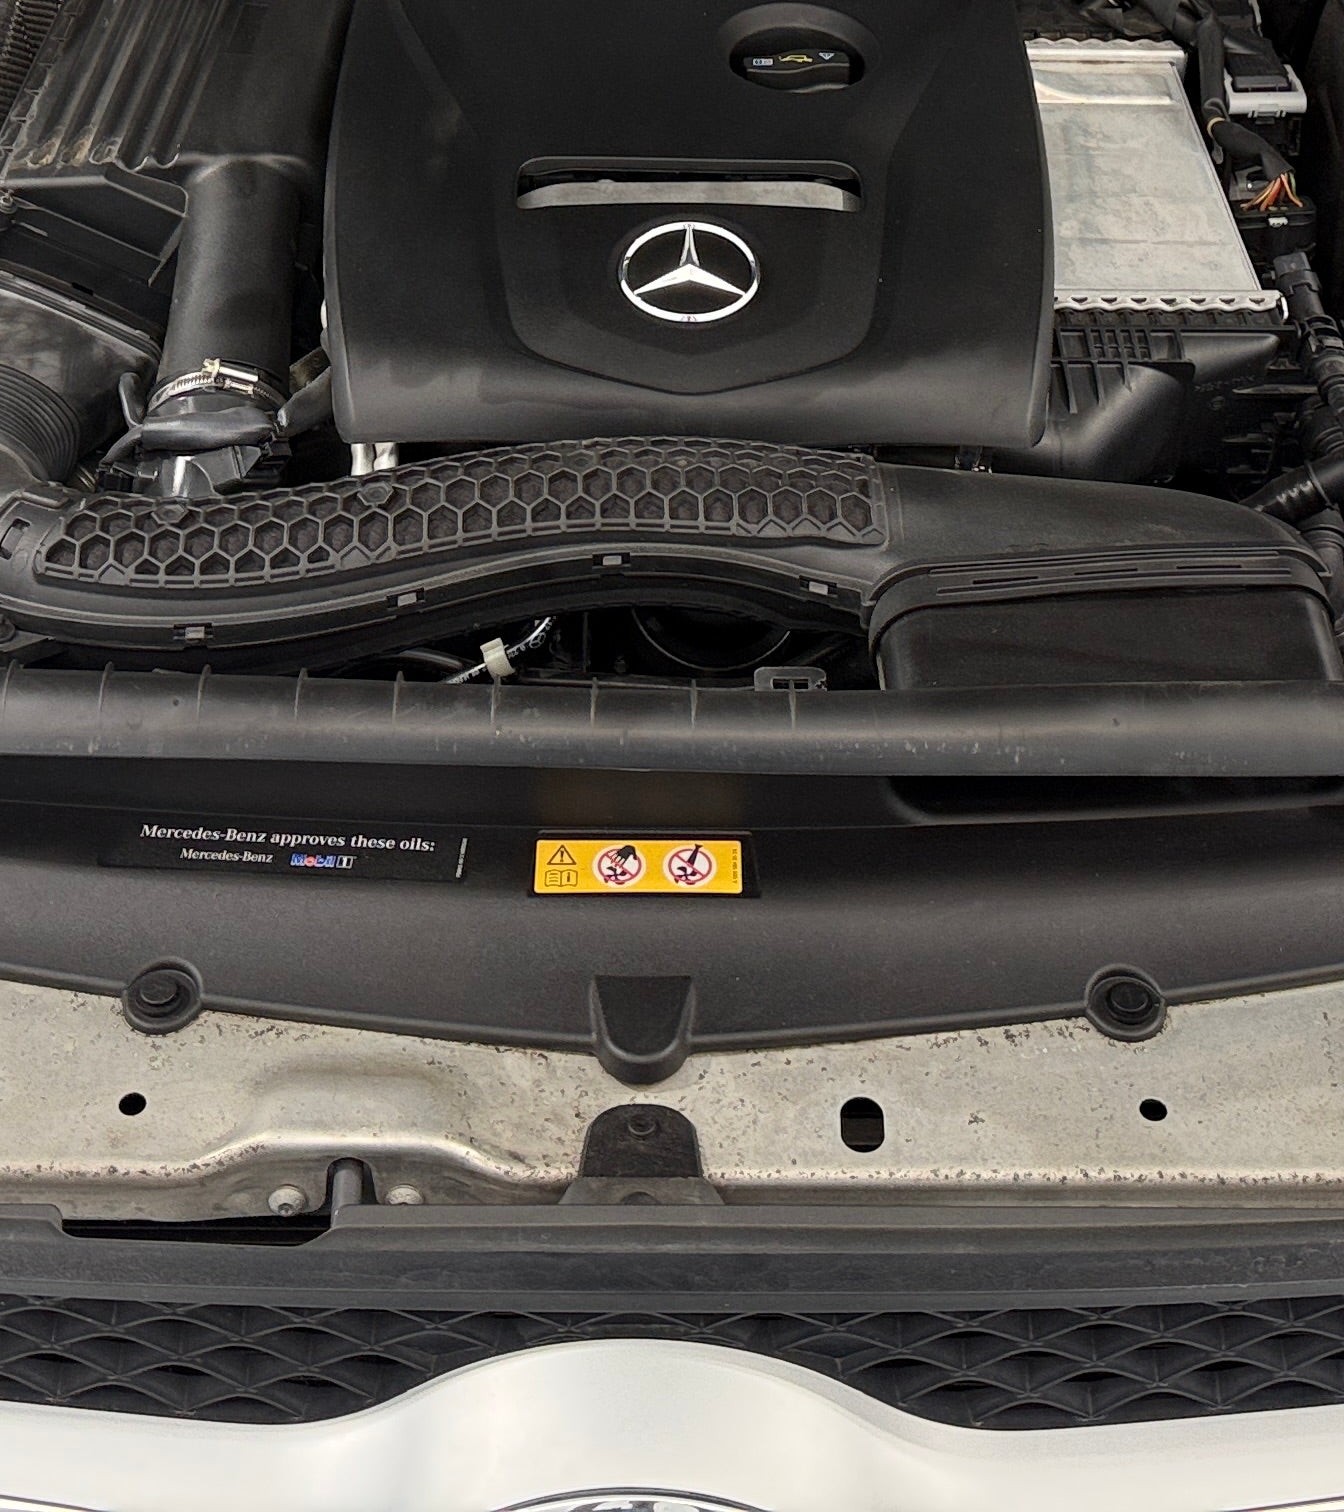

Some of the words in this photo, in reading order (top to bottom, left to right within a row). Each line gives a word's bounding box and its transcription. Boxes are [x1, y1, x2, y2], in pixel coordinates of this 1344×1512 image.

[139, 824, 267, 843] Mercedes-Benz
[270, 832, 346, 848] approves
[350, 834, 396, 850] these
[399, 837, 436, 852] oils:
[179, 847, 274, 863] Mercedes-Benz
